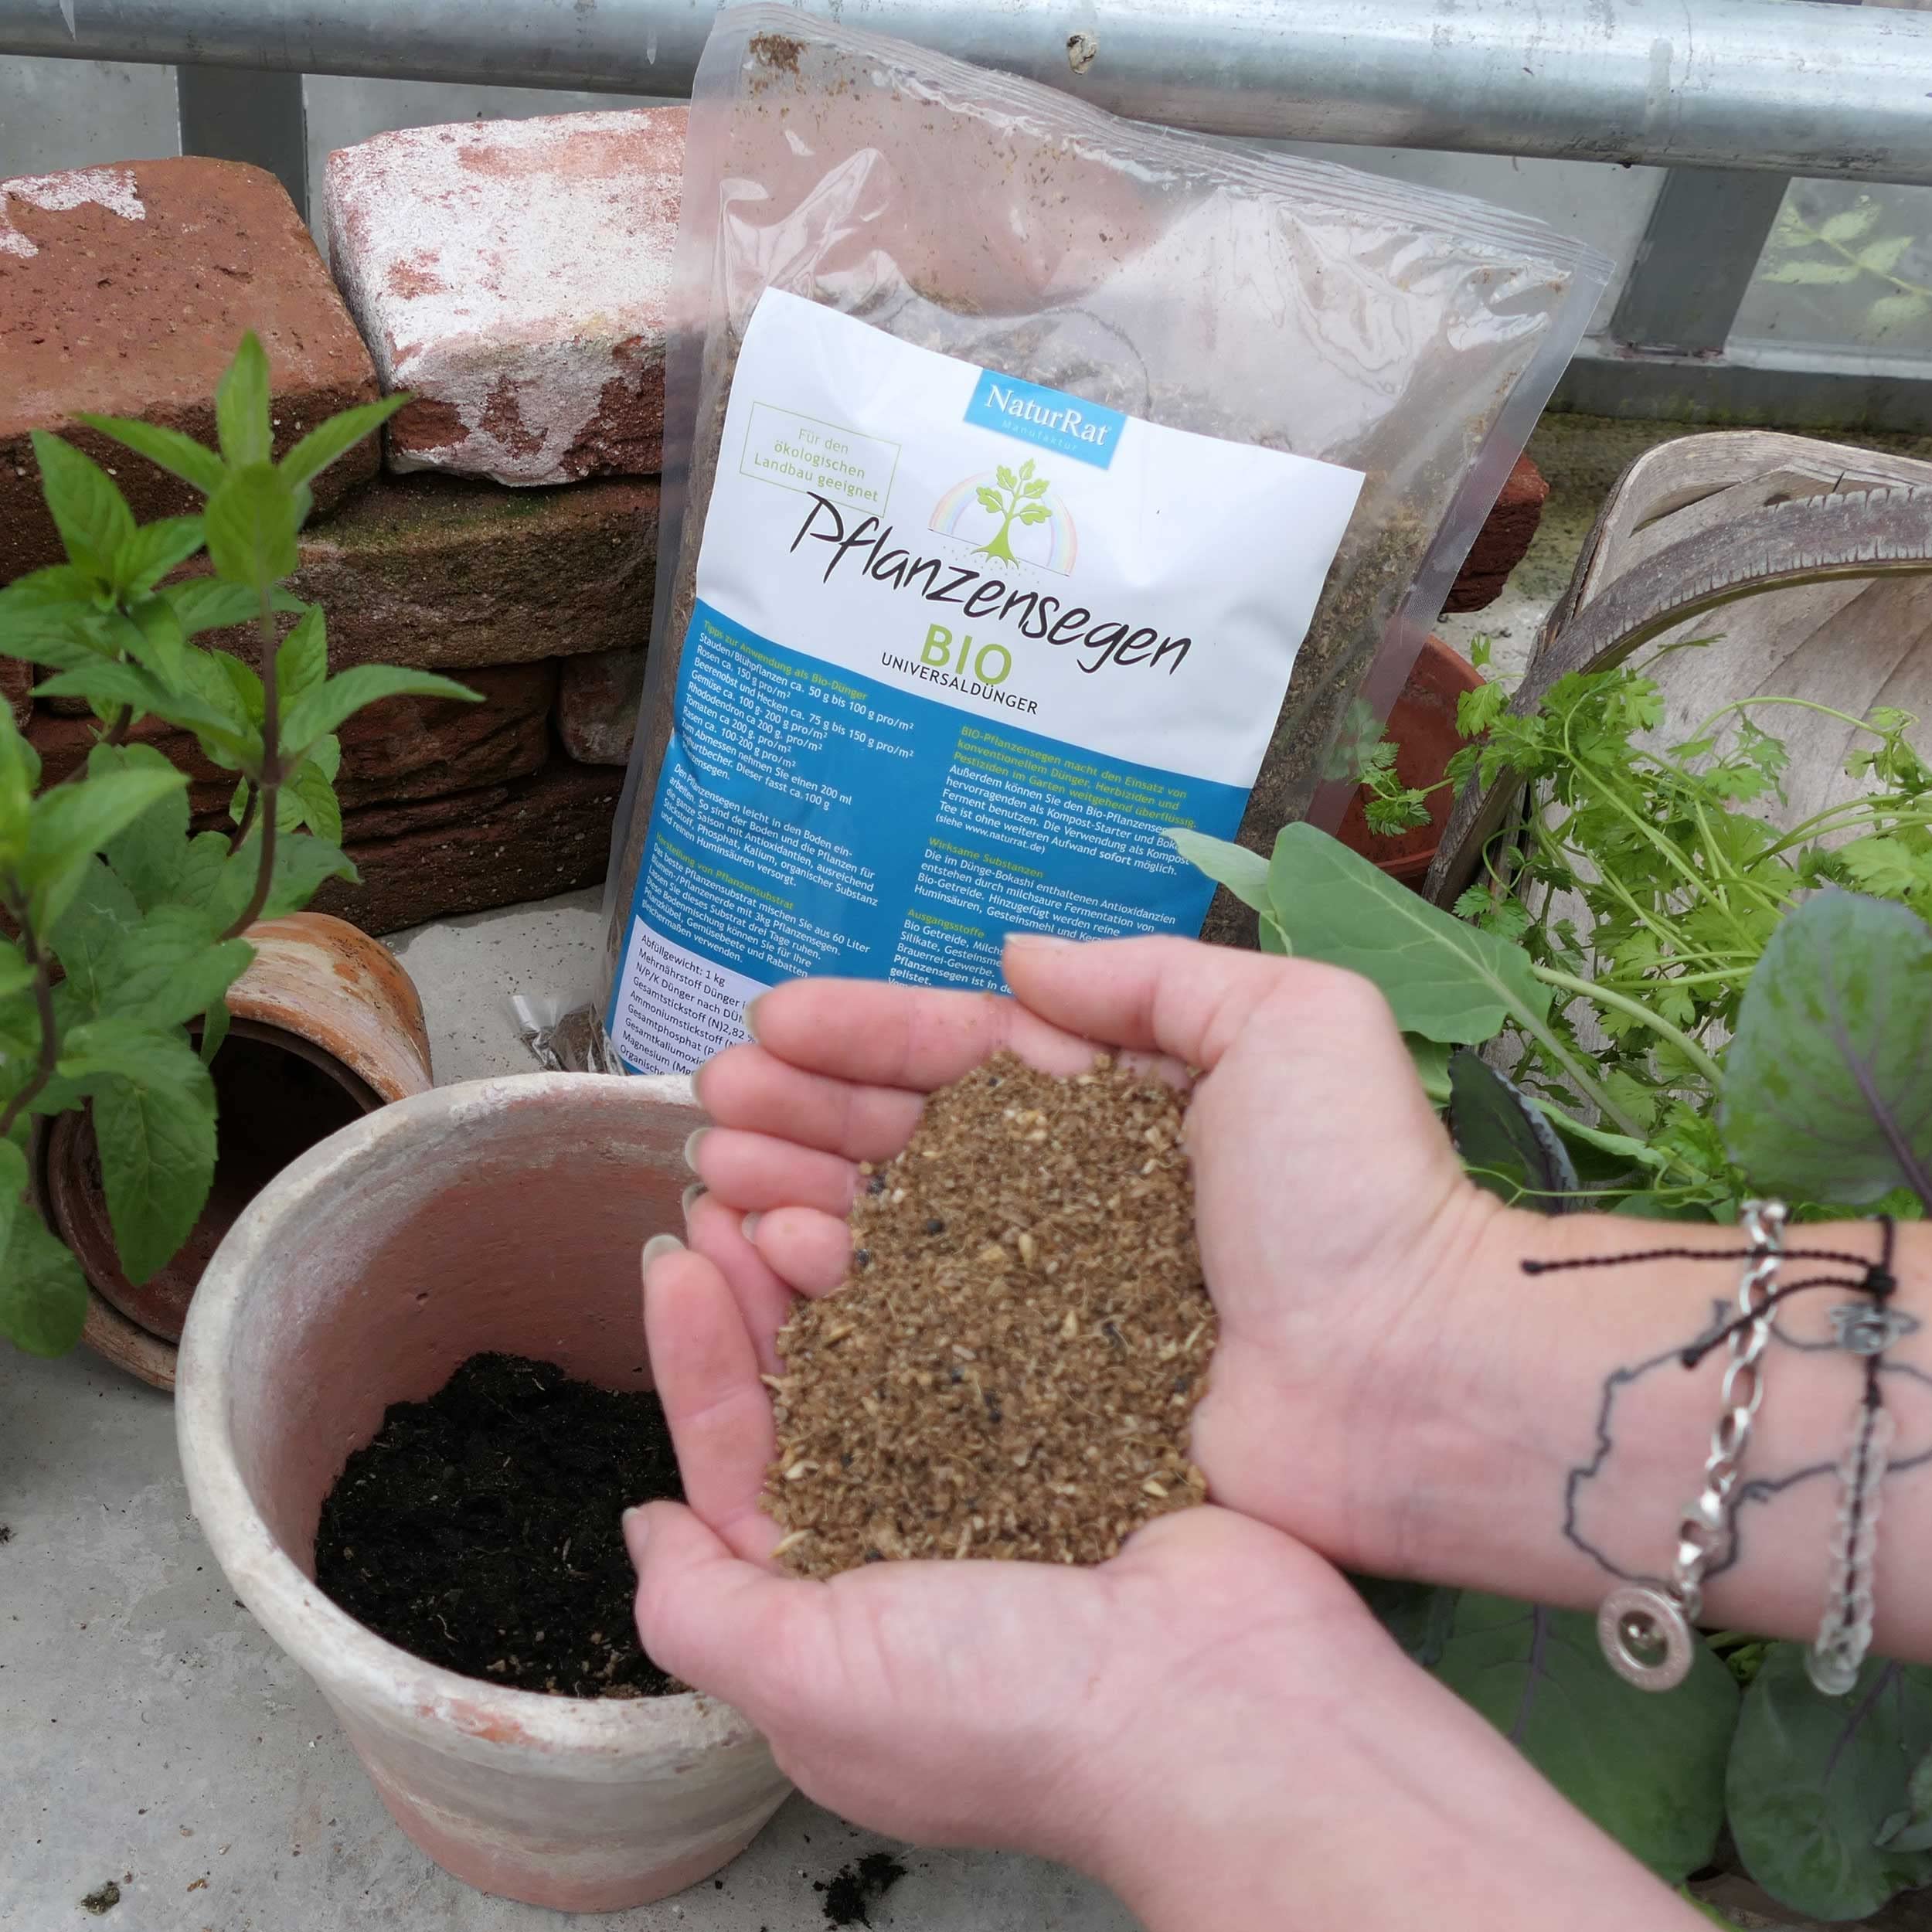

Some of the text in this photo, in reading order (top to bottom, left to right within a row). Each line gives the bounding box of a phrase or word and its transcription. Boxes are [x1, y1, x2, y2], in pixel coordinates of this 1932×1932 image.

[798, 429, 849, 454] Für den
[985, 384, 1108, 445] NaturRat
[1002, 420, 1078, 451] Manufaktur
[754, 454, 879, 503] Landbau geeignet
[774, 440, 865, 480] ökologischen
[790, 491, 1192, 675] Pflanzensegen
[696, 645, 791, 699] Rosen 150 pro/m²
[699, 631, 913, 731] Stauden/Blühpflanzen bis 100 pro/m²
[704, 619, 866, 700] Tipps zur Anwendung als Bio-Dünger
[881, 652, 1038, 715] UNIVERSALDÜNGER
[920, 624, 1012, 685] BIO
[685, 693, 791, 753] Tomaten pro/m²
[687, 682, 822, 752] Rhododendron pro/m²
[691, 669, 827, 740] Gemüse pro/m²
[694, 657, 914, 758] Beerenobst und Hecken pro/m²
[682, 706, 796, 768] Rasen 100-200 pro/m²
[695, 729, 817, 792] Abmessen nehmen einen
[961, 726, 1186, 799] BIO-Pflanzensegen macht den Einsatz von
[736, 761, 787, 794] Dieser fasst
[950, 764, 1083, 812] Außerdem können Sie den
[954, 751, 1195, 829] Pestiziden Garten weitgehend überflüssig.
[957, 739, 1179, 810] konventionellem Dünger, Herbiziden und
[710, 806, 857, 873] sind Boden Pflanzen
[742, 804, 770, 824] leicht
[804, 830, 831, 849] Boden
[834, 845, 852, 856] ein-
[935, 812, 1046, 855] (siehe www.naturrat.de)
[939, 801, 1175, 876] Tee ist ohne weiteren Aufwand sofort möglich.
[942, 789, 1143, 855] Ferment benutzen. Die Verwendung als
[946, 776, 1154, 844] hervorragenden als Kompost-Starter und
[673, 821, 795, 887] reinen Huminsäuren versorgt.
[675, 796, 873, 891] ganze Saison Antioxidantien, ausreichend
[697, 821, 740, 852] Phosphat,
[743, 844, 777, 866] Kalium,
[781, 860, 832, 889] organischer
[835, 883, 878, 906] Substanz
[928, 837, 1043, 879] Wirksame Substanzen
[665, 851, 870, 954] beste Pflanzensubstrat mischen Liter
[914, 884, 1077, 939] Huminsäuren, Gesteinsmehl und
[917, 872, 1119, 936] Bio-Getreide. Hinzugefügt werden reine
[921, 862, 1154, 932] entstehen durch milchsaure Fermentation von
[925, 849, 1175, 925] Die Dünge-Bokashi enthaltenen Antioxidanzien
[663, 889, 724, 932] Bodenmischung
[726, 923, 758, 945] können
[793, 952, 811, 967] Ihre
[682, 889, 707, 911] dieses
[709, 905, 747, 929] Substrat
[748, 922, 767, 937] drei
[768, 931, 789, 948] Tage
[791, 944, 820, 961] ruhen.
[685, 917, 808, 978] Gemüsebeete Rabatten
[692, 935, 741, 963] verwenden.
[773, 919, 840, 955] Pflanzensegen.
[900, 931, 939, 952] Silikate,
[904, 919, 968, 948] Bio Getreide,
[907, 908, 984, 939] Ausgangsstoffe
[638, 948, 739, 1008] Mehrnährstoff Dünger
[641, 934, 702, 977] Abfüllgewicht:
[889, 968, 930, 986] gelistet.
[894, 954, 984, 988] Pflanzensegen ist
[631, 989, 723, 1047] Ammoniumstickstoff
[633, 975, 706, 1022] Gesamtstickstoff
[635, 961, 721, 1015] N/P/K Dünger nach
[622, 1030, 669, 1066] Magnesium
[628, 1002, 702, 1052] Gesamtphosphat
